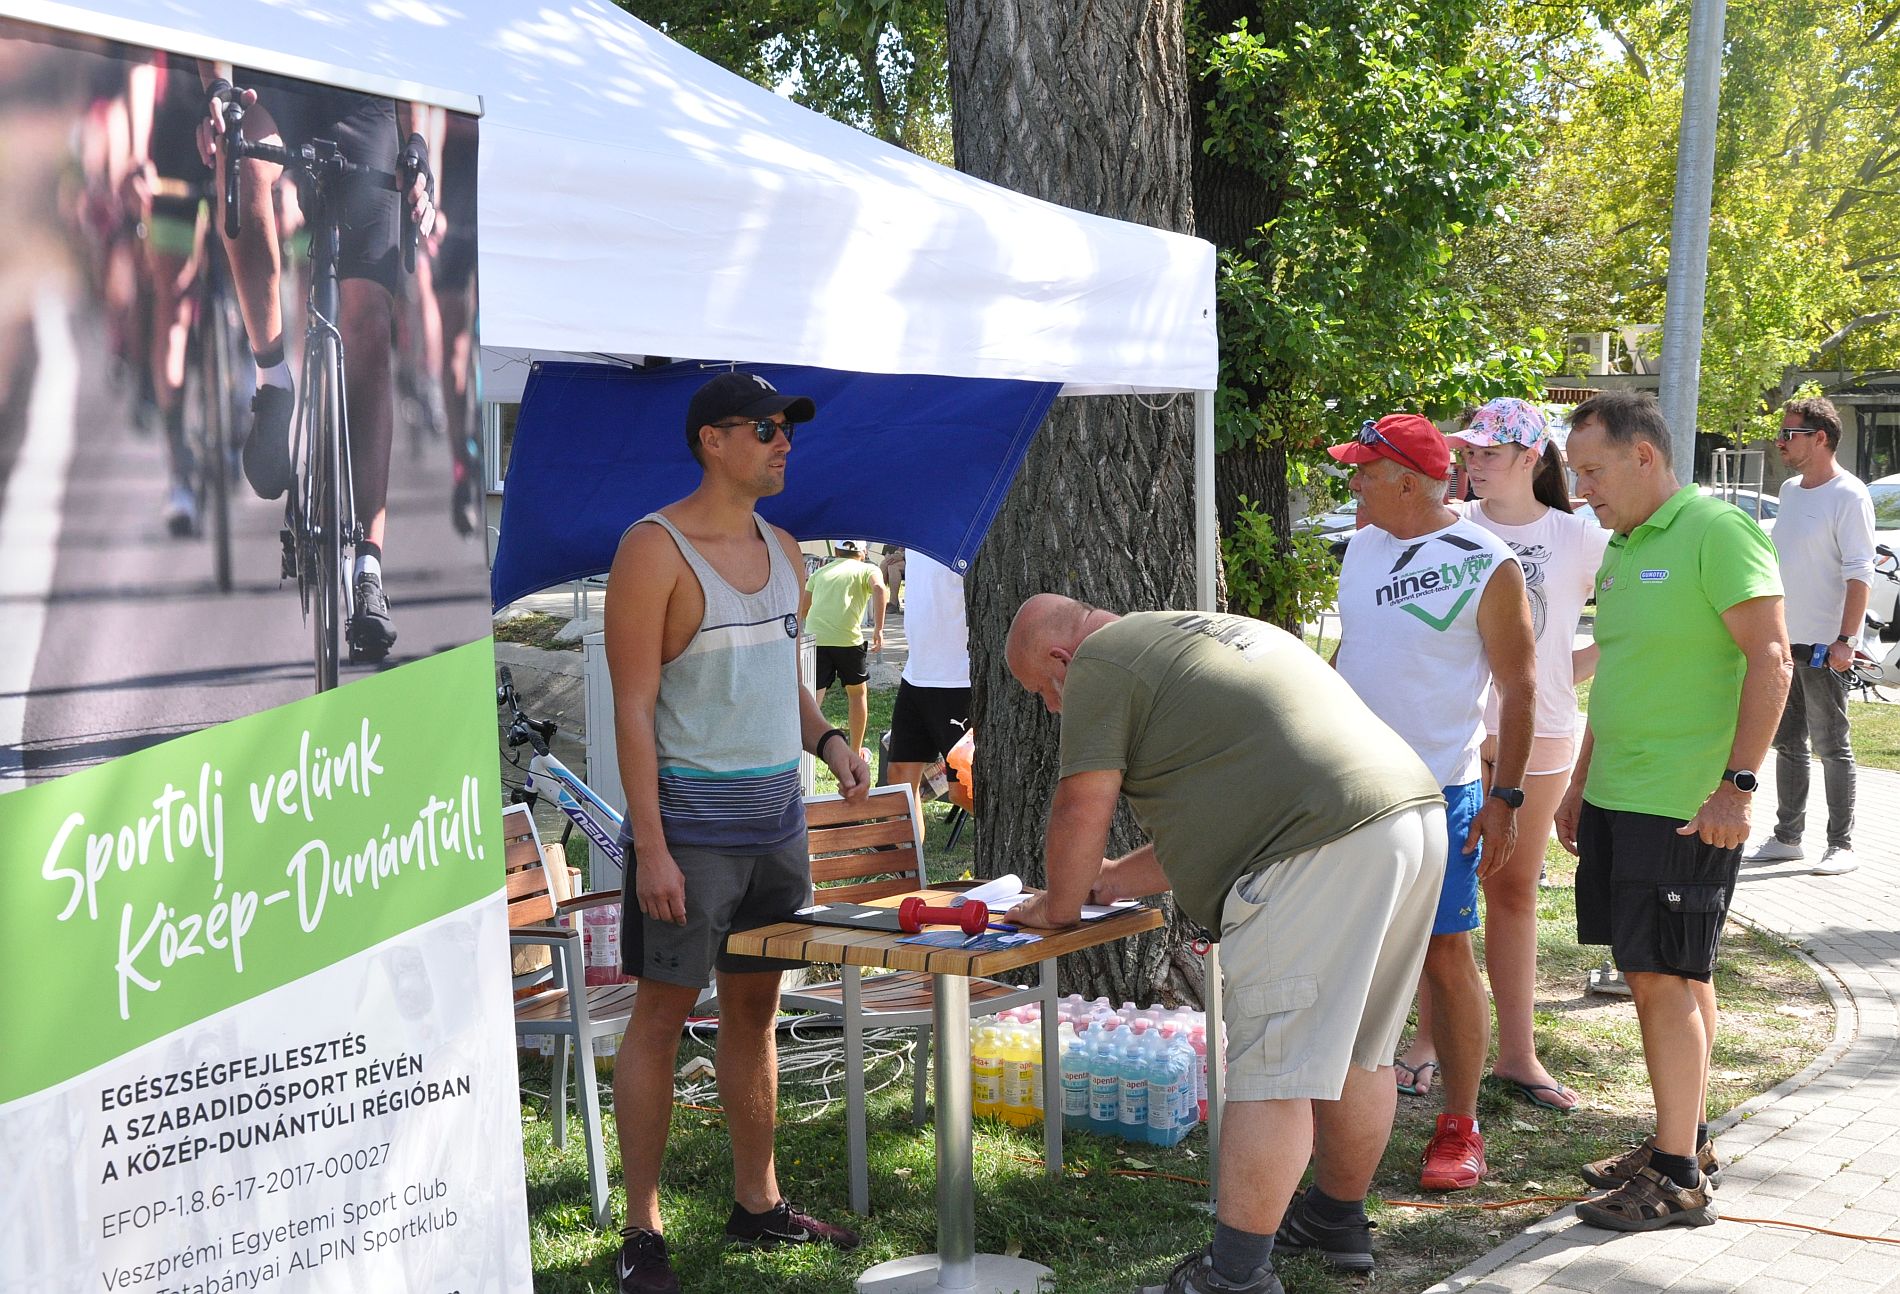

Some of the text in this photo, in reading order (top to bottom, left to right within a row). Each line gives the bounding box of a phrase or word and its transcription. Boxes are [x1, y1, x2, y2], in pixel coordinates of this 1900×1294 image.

[42, 717, 384, 921] Sportolj velünk
[115, 775, 484, 1020] Közép-Dunántúl!
[101, 1034, 367, 1112] EGÉSZSÉGFEJLESZTÉS
[101, 1053, 424, 1148] A SZABADIDŐSPORT RÉVÉN
[101, 1075, 471, 1184] A KÖZÉP-DUNÁNTÚLI RÉGIÓBAN
[102, 1142, 391, 1239] EFOP-1.8.6-17-2017-00027
[102, 1178, 448, 1292] Veszprémi Egyetemi Sport Club
[288, 1235, 357, 1272] ALPIN
[363, 1208, 459, 1253] Sportklub
